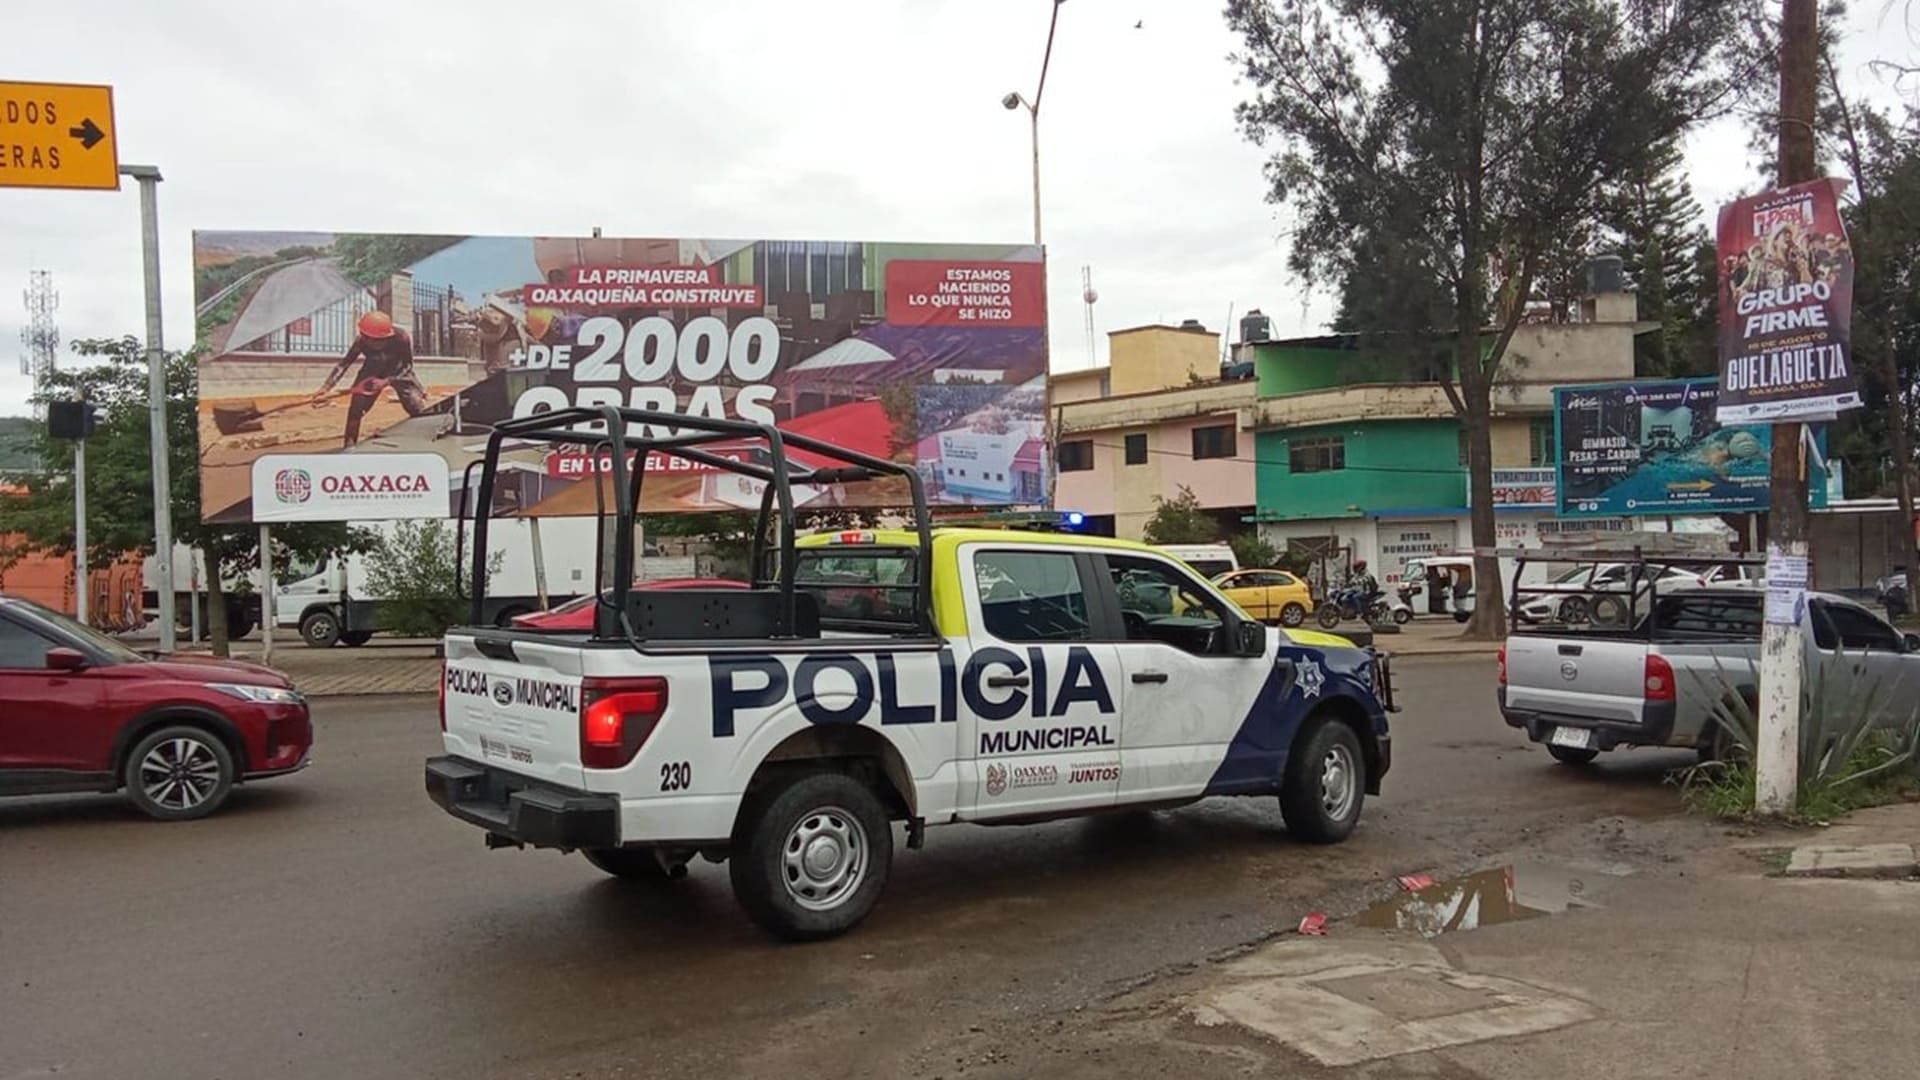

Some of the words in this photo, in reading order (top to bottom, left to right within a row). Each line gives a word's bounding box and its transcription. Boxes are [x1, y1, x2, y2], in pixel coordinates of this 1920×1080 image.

[0, 101, 57, 125] DOS
[578, 269, 601, 283] LA
[605, 269, 709, 284] PRIMAVERA
[947, 269, 1012, 281] ESTAMOS
[532, 287, 647, 304] OAXAQUEÑA
[651, 289, 756, 304] CONSTRUYE
[939, 282, 1012, 293] HACIENDO
[909, 295, 928, 305] LO
[931, 295, 960, 307] QUE
[963, 295, 1012, 306] NUNCA
[1737, 280, 1831, 315] GRUPO
[959, 308, 976, 319] SE
[979, 309, 1012, 319] HIZO
[1744, 304, 1829, 339] FIRME
[1778, 332, 1828, 345] AGOSTO
[573, 316, 781, 383] 2000
[1727, 344, 1847, 392] GUELAGUETZA
[511, 385, 778, 444] OBRAS
[1582, 436, 1627, 449] GIMNASIO
[1569, 450, 1598, 462] PESAS
[1607, 447, 1640, 461] CARDIO
[559, 458, 584, 472] EN
[644, 457, 665, 472] EL
[321, 475, 431, 493] OAXACA
[1400, 533, 1431, 541] AYUDA
[447, 668, 488, 697] POLICIA
[516, 678, 577, 713] MUNICIPAL
[707, 646, 1116, 738] POLICIA
[980, 725, 1115, 754] MUNICIPAL
[660, 761, 691, 792] 230
[1014, 765, 1058, 778] OAXACA
[1068, 768, 1119, 784] JUNTOS
